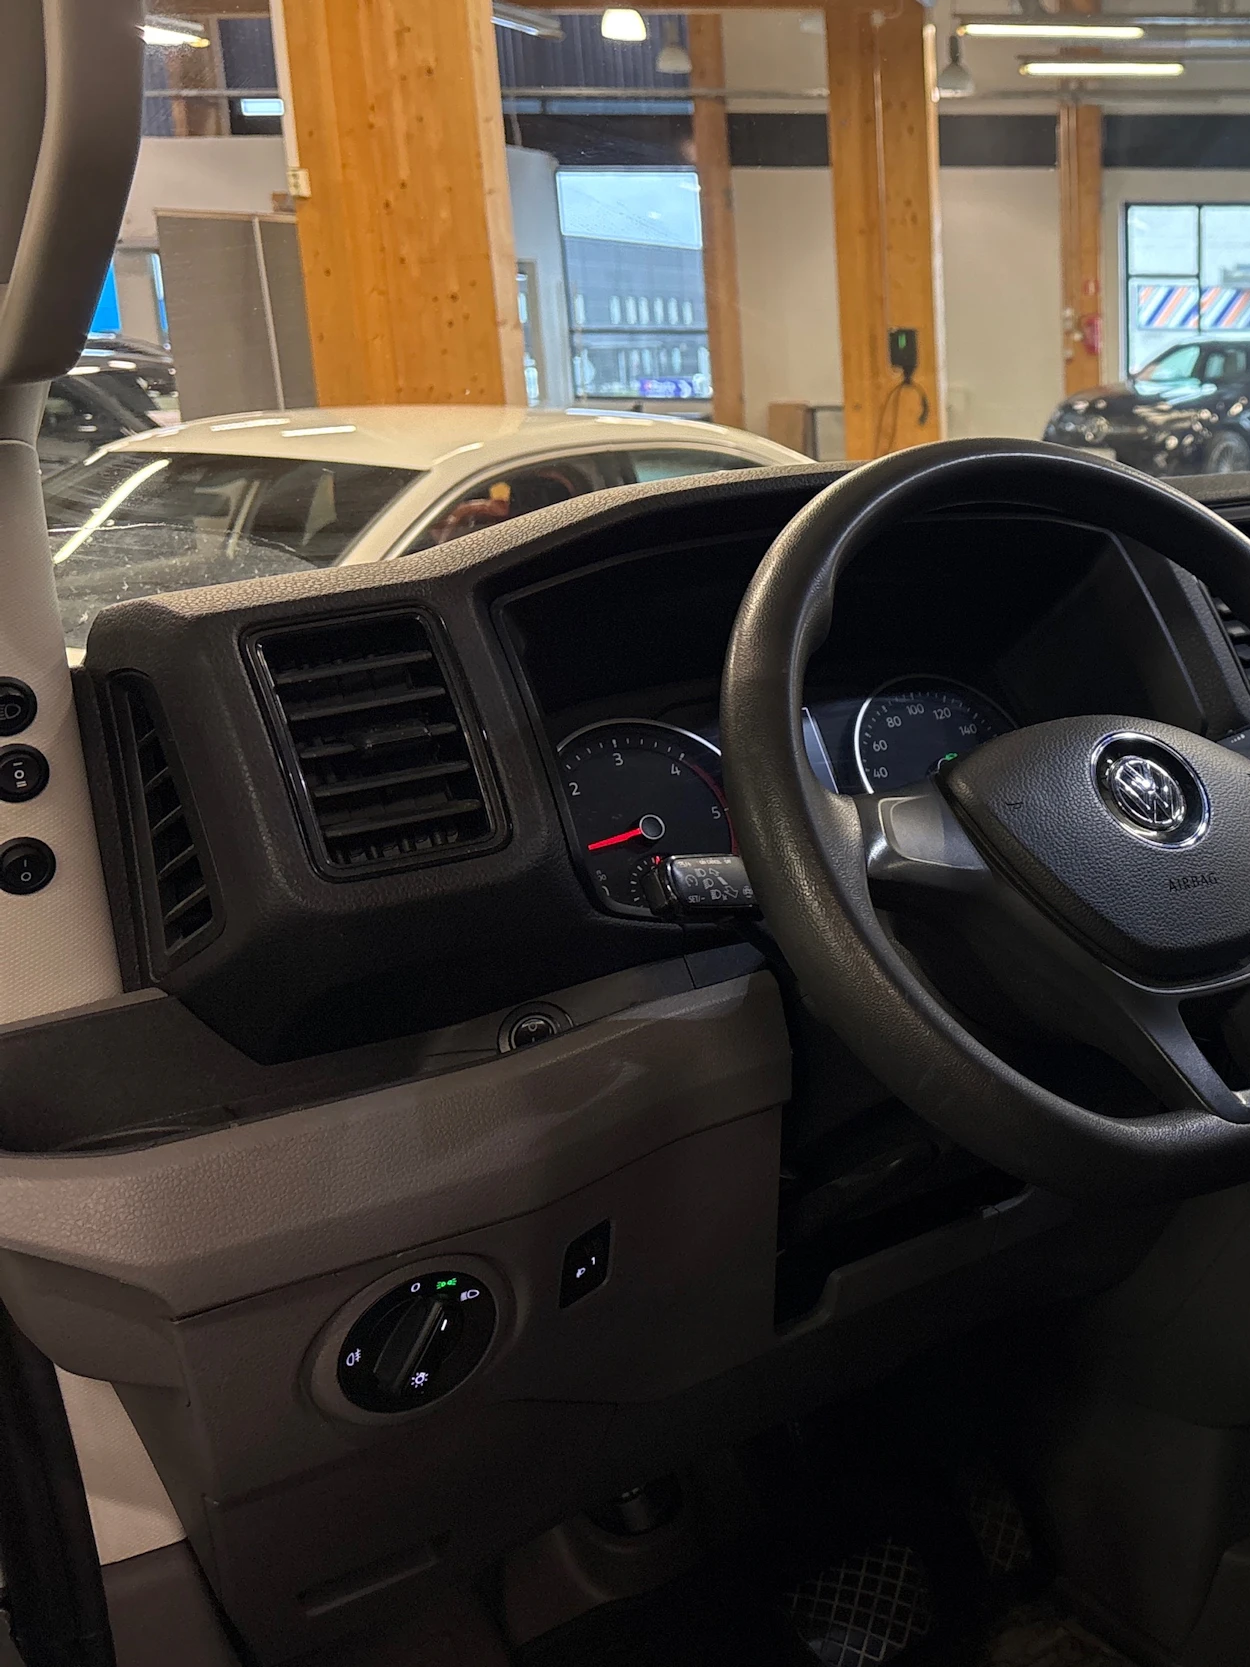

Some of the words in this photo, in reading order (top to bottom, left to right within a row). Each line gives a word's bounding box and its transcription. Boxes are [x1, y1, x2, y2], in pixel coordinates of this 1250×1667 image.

[906, 703, 925, 716] 100
[933, 707, 952, 720] 120
[886, 715, 902, 729] 80
[959, 723, 978, 736] 140
[872, 739, 888, 752] 60
[612, 752, 624, 766] 3
[670, 763, 681, 777] 4
[873, 766, 889, 778] 40
[568, 782, 581, 796] 2
[711, 806, 721, 820] 5
[1167, 872, 1219, 892] AIRBAG
